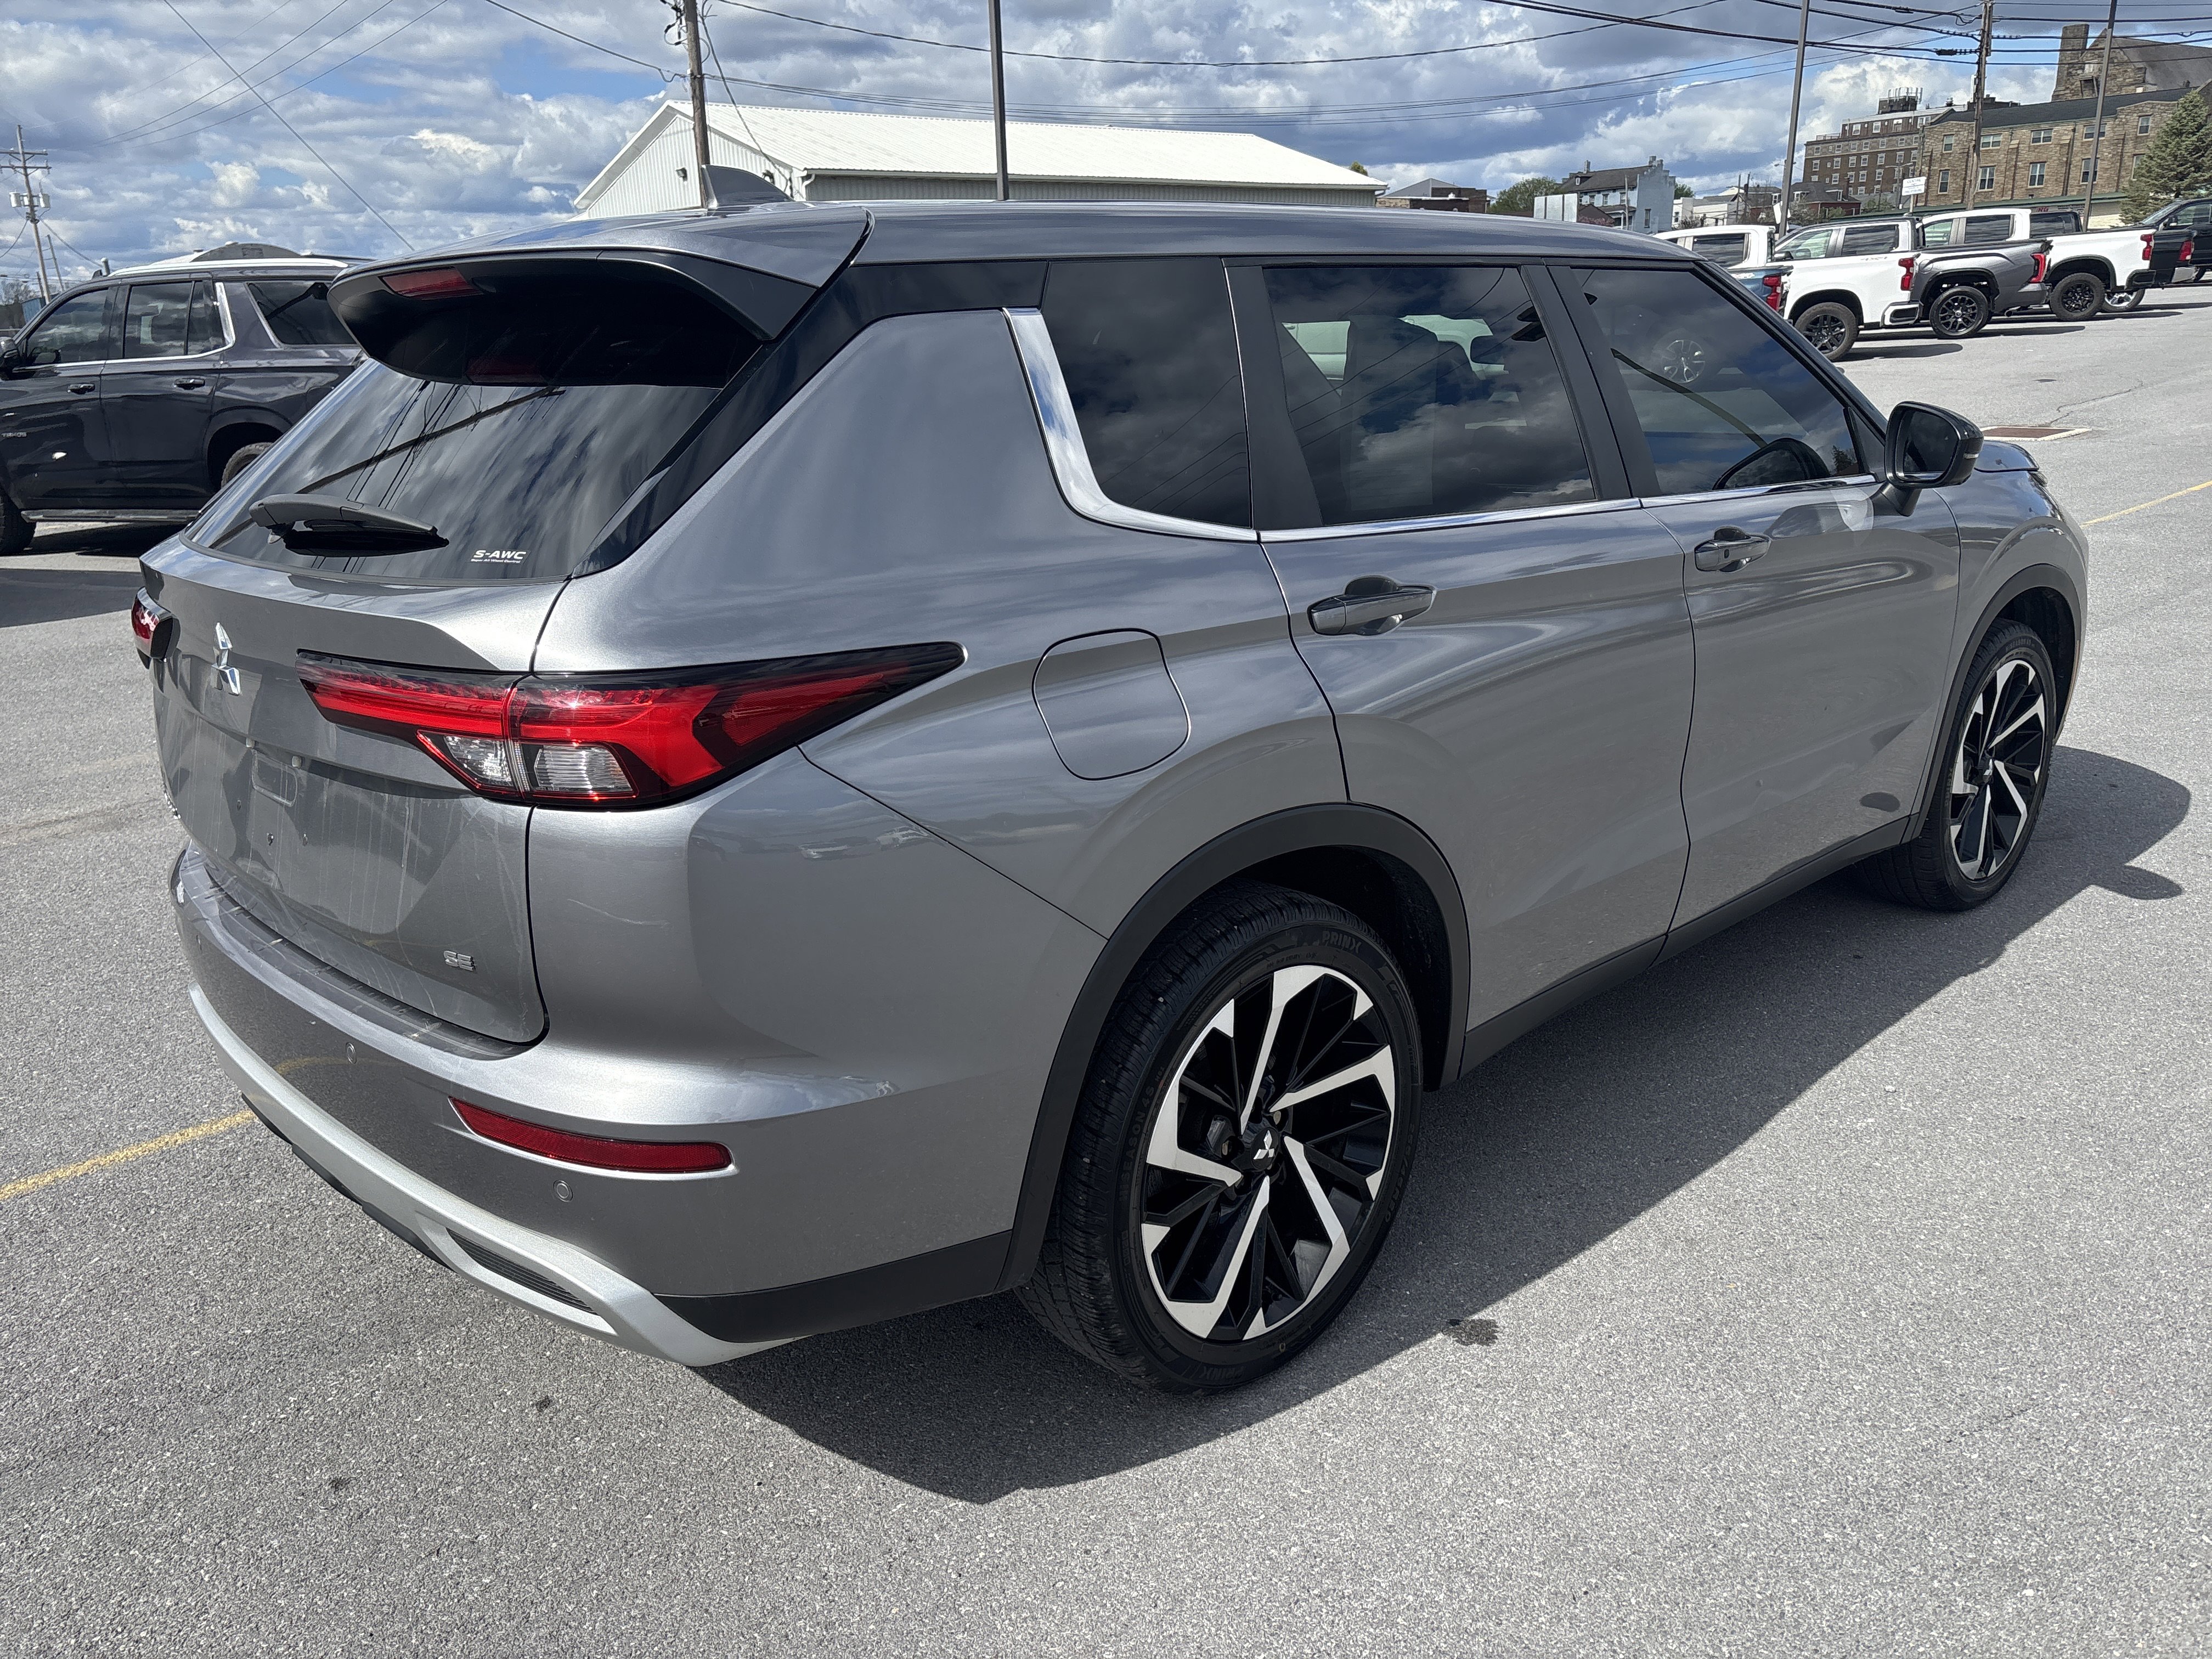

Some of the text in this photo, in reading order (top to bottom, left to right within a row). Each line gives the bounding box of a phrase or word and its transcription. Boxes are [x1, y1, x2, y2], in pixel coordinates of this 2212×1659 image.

[473, 550, 527, 560] S-AWC
[1322, 930, 1362, 954] PRINX
[443, 950, 475, 971] SE
